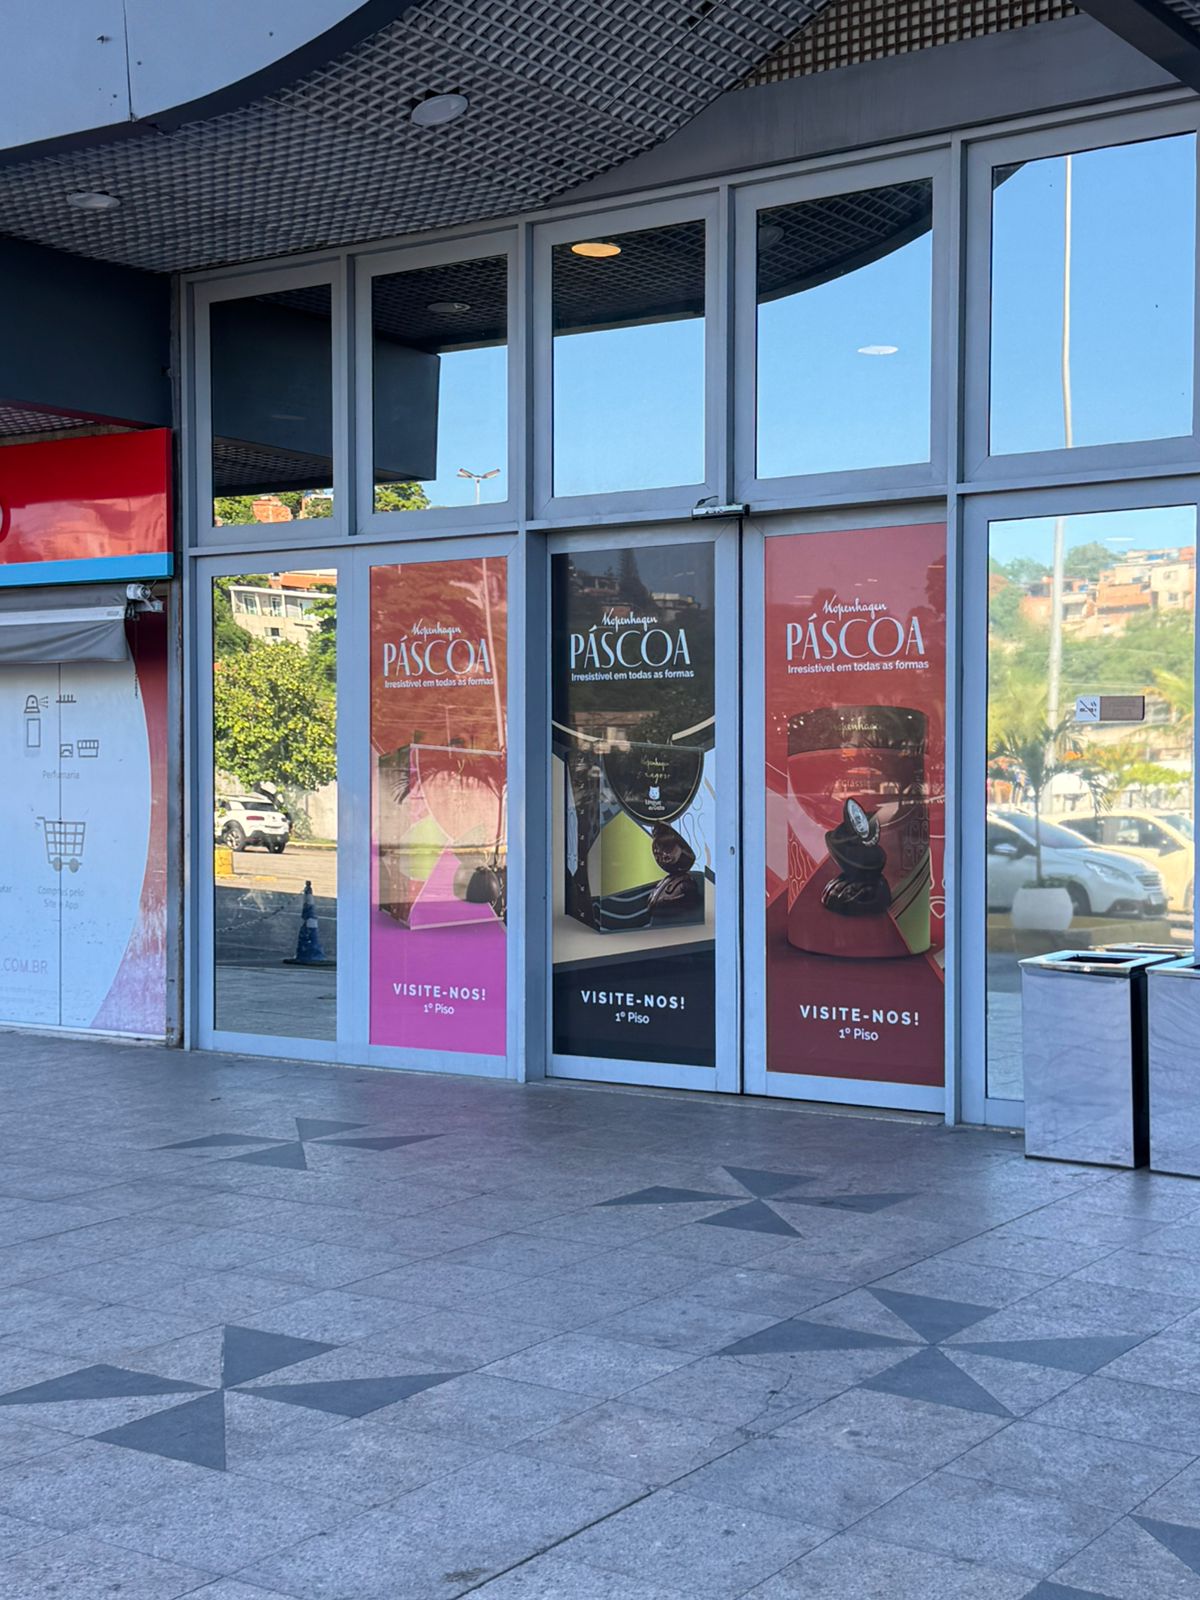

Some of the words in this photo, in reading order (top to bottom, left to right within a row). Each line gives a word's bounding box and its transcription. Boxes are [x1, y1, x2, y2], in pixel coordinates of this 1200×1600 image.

[823, 594, 888, 621] Kopenhagen
[411, 618, 462, 642] Kopenhagen
[601, 607, 658, 632] Kopenhagen
[570, 624, 691, 669] PÁSCOA
[786, 613, 925, 661] PÁSCOA
[383, 635, 491, 677] PÁSCOA
[836, 664, 852, 672] em
[853, 661, 881, 672] todas
[882, 661, 894, 670] as
[895, 659, 930, 670] formas
[422, 679, 435, 688] em
[435, 677, 457, 687] todas
[457, 678, 467, 686] as
[467, 676, 495, 687] formas
[613, 672, 628, 681] em
[628, 670, 653, 680] todas
[653, 671, 663, 679] as
[664, 668, 695, 678] formas
[392, 983, 486, 1001] VISITE-NOS!
[580, 989, 685, 1010] VISITE-NOS!
[434, 1003, 455, 1015] Piso
[627, 1011, 650, 1024] Piso
[799, 1004, 919, 1026] VISITE-NOS!
[853, 1027, 879, 1041] Piso
